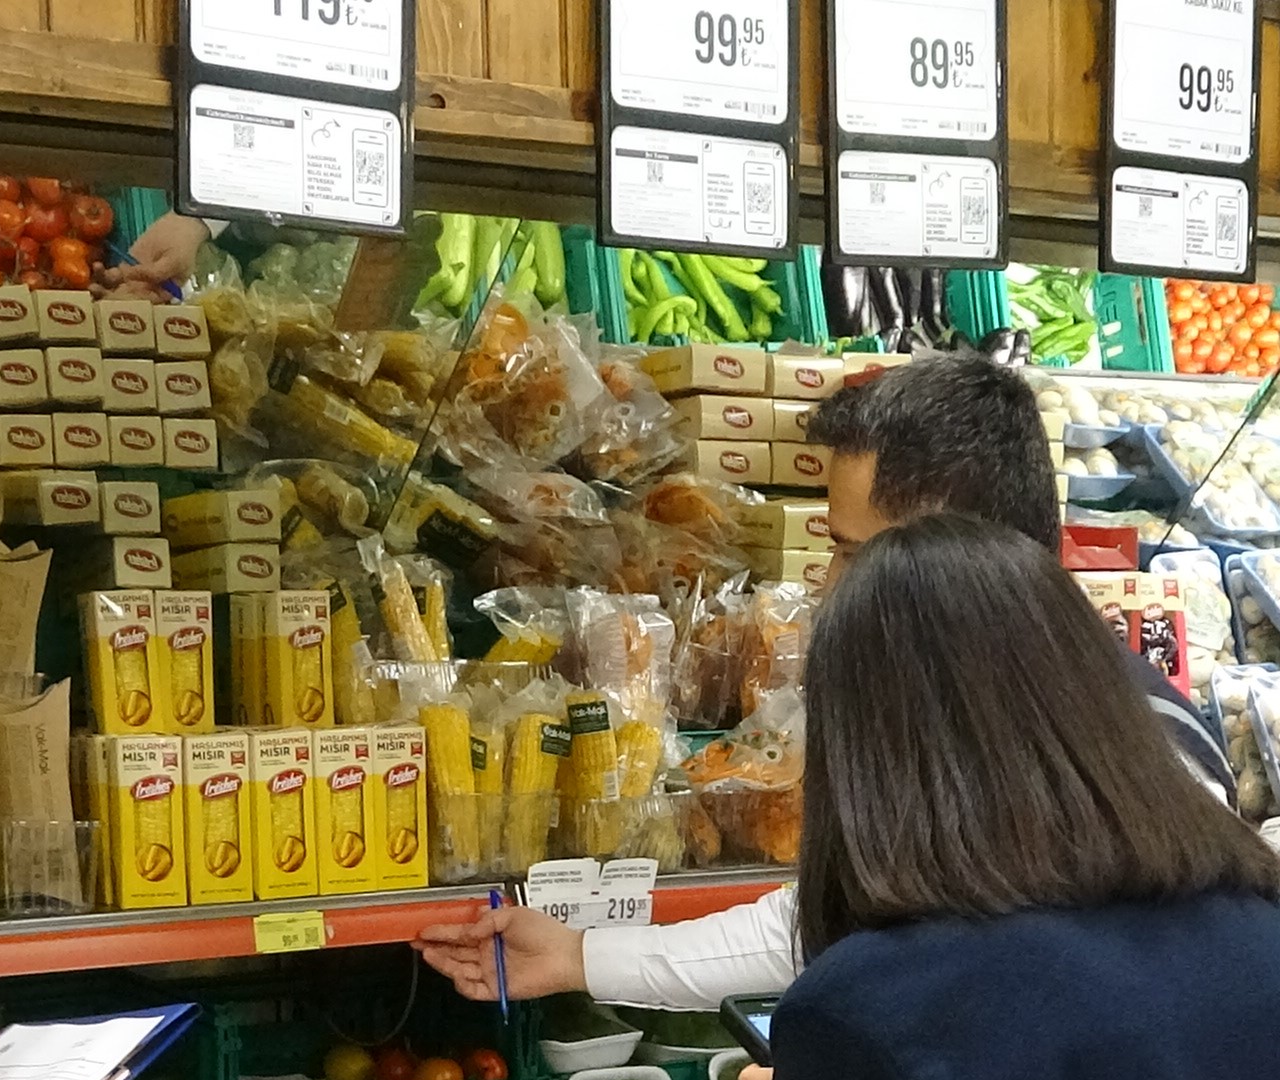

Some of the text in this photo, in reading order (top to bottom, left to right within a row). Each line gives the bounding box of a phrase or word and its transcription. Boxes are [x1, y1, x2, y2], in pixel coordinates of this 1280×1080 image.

[320, 743, 350, 754] MISIR
[377, 741, 406, 751] MISIR
[122, 752, 157, 762] MISIR
[192, 750, 225, 761] MISIR
[260, 746, 291, 758] MISIR
